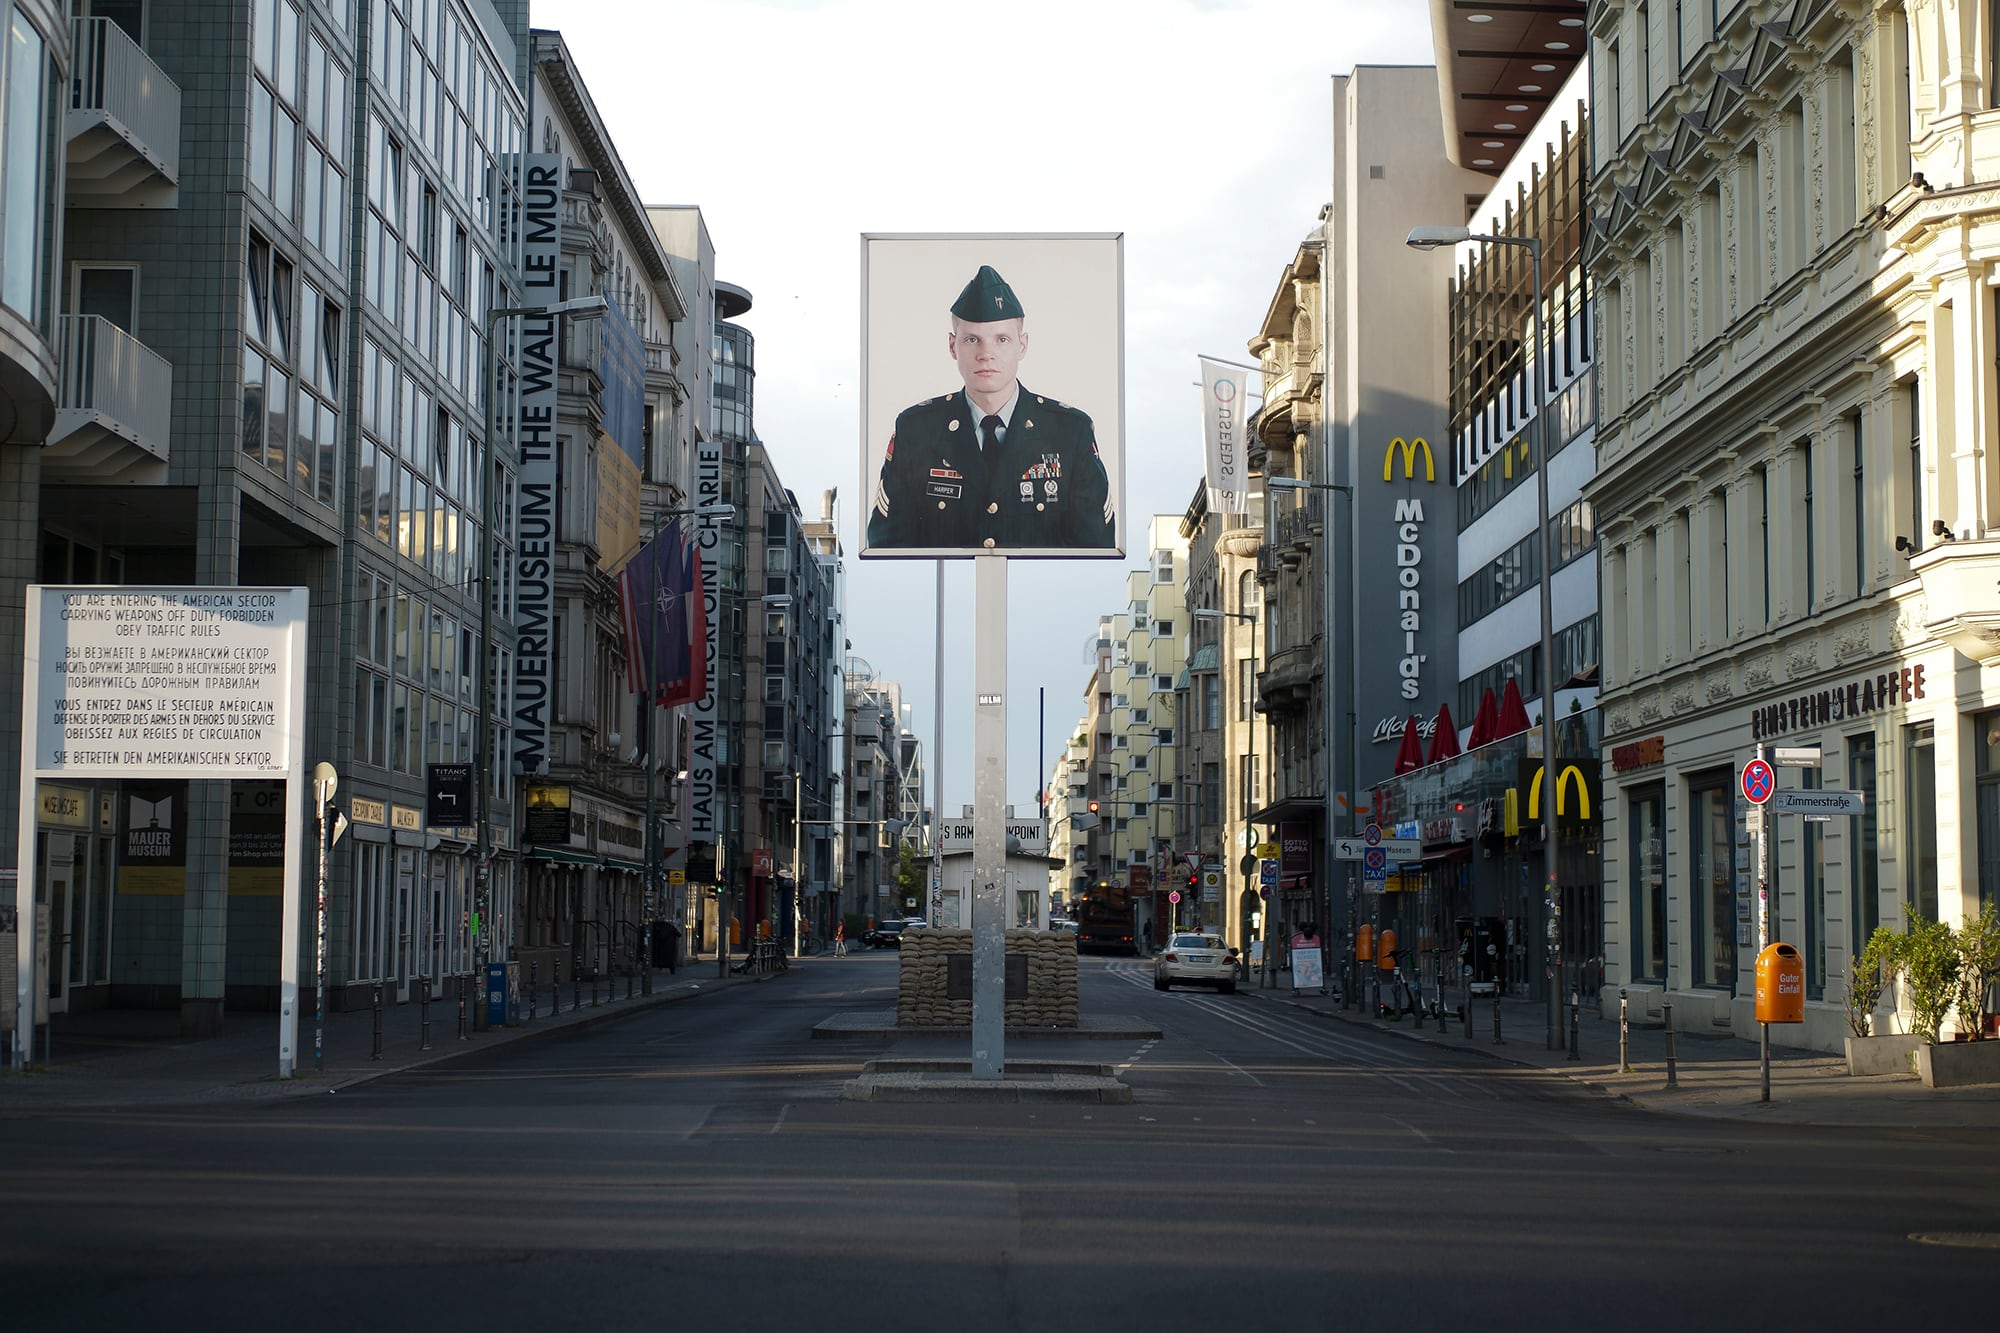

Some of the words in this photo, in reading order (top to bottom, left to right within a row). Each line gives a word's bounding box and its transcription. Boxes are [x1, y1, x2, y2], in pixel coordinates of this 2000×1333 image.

[526, 166, 560, 243] MUR
[526, 254, 555, 287] LE
[521, 406, 552, 465] THE
[934, 486, 954, 495] HARPER
[699, 451, 719, 549] CHARLIE
[62, 595, 82, 607] YOU
[87, 595, 105, 607] ARE
[111, 595, 157, 607] ENTERING
[162, 595, 177, 607] THE
[183, 595, 233, 607] AMERICAN
[238, 595, 276, 607] SECTOR
[1394, 499, 1426, 700] McDonald's
[60, 610, 111, 621] CARRYING
[116, 610, 163, 621] WEAPONS
[168, 610, 185, 621] OFF
[191, 610, 215, 621] DUTY
[220, 610, 274, 621] FORBIDDEN
[514, 484, 552, 761] MAUERMUSEUM
[116, 625, 142, 636] OBEY
[147, 625, 185, 636] TRAFFIC
[191, 625, 220, 636] RULES
[65, 647, 80, 659] ВЫ
[140, 647, 146, 659] В
[151, 646, 230, 659] АМЕРИКАНСКИЙ
[234, 647, 269, 659] СЕКТОР
[56, 662, 87, 674] НОСИТЬ
[90, 662, 122, 674] ОРУЖИЕ
[178, 662, 183, 674] В
[249, 662, 276, 674] ВРЕМЯ
[142, 677, 199, 689] ДОРОЖНЫМ
[206, 677, 260, 689] ПРАВИЛАМ
[55, 699, 80, 711] VOUS
[87, 699, 121, 711] ENTREZ
[127, 699, 152, 711] DANS
[158, 699, 166, 711] LE
[172, 699, 214, 711] SECTEUR
[220, 697, 274, 712] AMÉRICAIN
[1752, 690, 1830, 740] EINSTEIN
[1847, 664, 1926, 716] KAFFEE
[54, 714, 87, 725] DEFENSE
[91, 714, 100, 725] DE
[102, 714, 131, 725] PORTER
[134, 714, 148, 725] DES
[151, 714, 176, 725] ARMES
[179, 714, 190, 725] EN
[193, 714, 224, 725] DEHORS
[228, 714, 239, 725] DU
[242, 714, 275, 725] SERVICE
[65, 728, 112, 739] OBEISSEZ
[119, 728, 138, 739] AUX
[143, 728, 177, 739] REGLES
[183, 728, 194, 739] DE
[200, 728, 262, 739] CIRCULATION
[694, 721, 714, 760] AM
[53, 751, 69, 765] SIE
[74, 751, 119, 765] BETRETEN
[124, 751, 142, 765] DEN
[146, 751, 230, 765] AMERIKANISCHEN
[235, 751, 271, 765] SEKTOR
[692, 768, 713, 832] HAUS
[1787, 795, 1850, 809] Zimmerstraße
[129, 831, 171, 845] MAUER
[955, 826, 973, 839] ARM
[128, 846, 171, 857] MUSEUM
[1366, 870, 1384, 878] TAXI
[1780, 973, 1799, 982] Guter
[1779, 985, 1800, 993] Einfall
